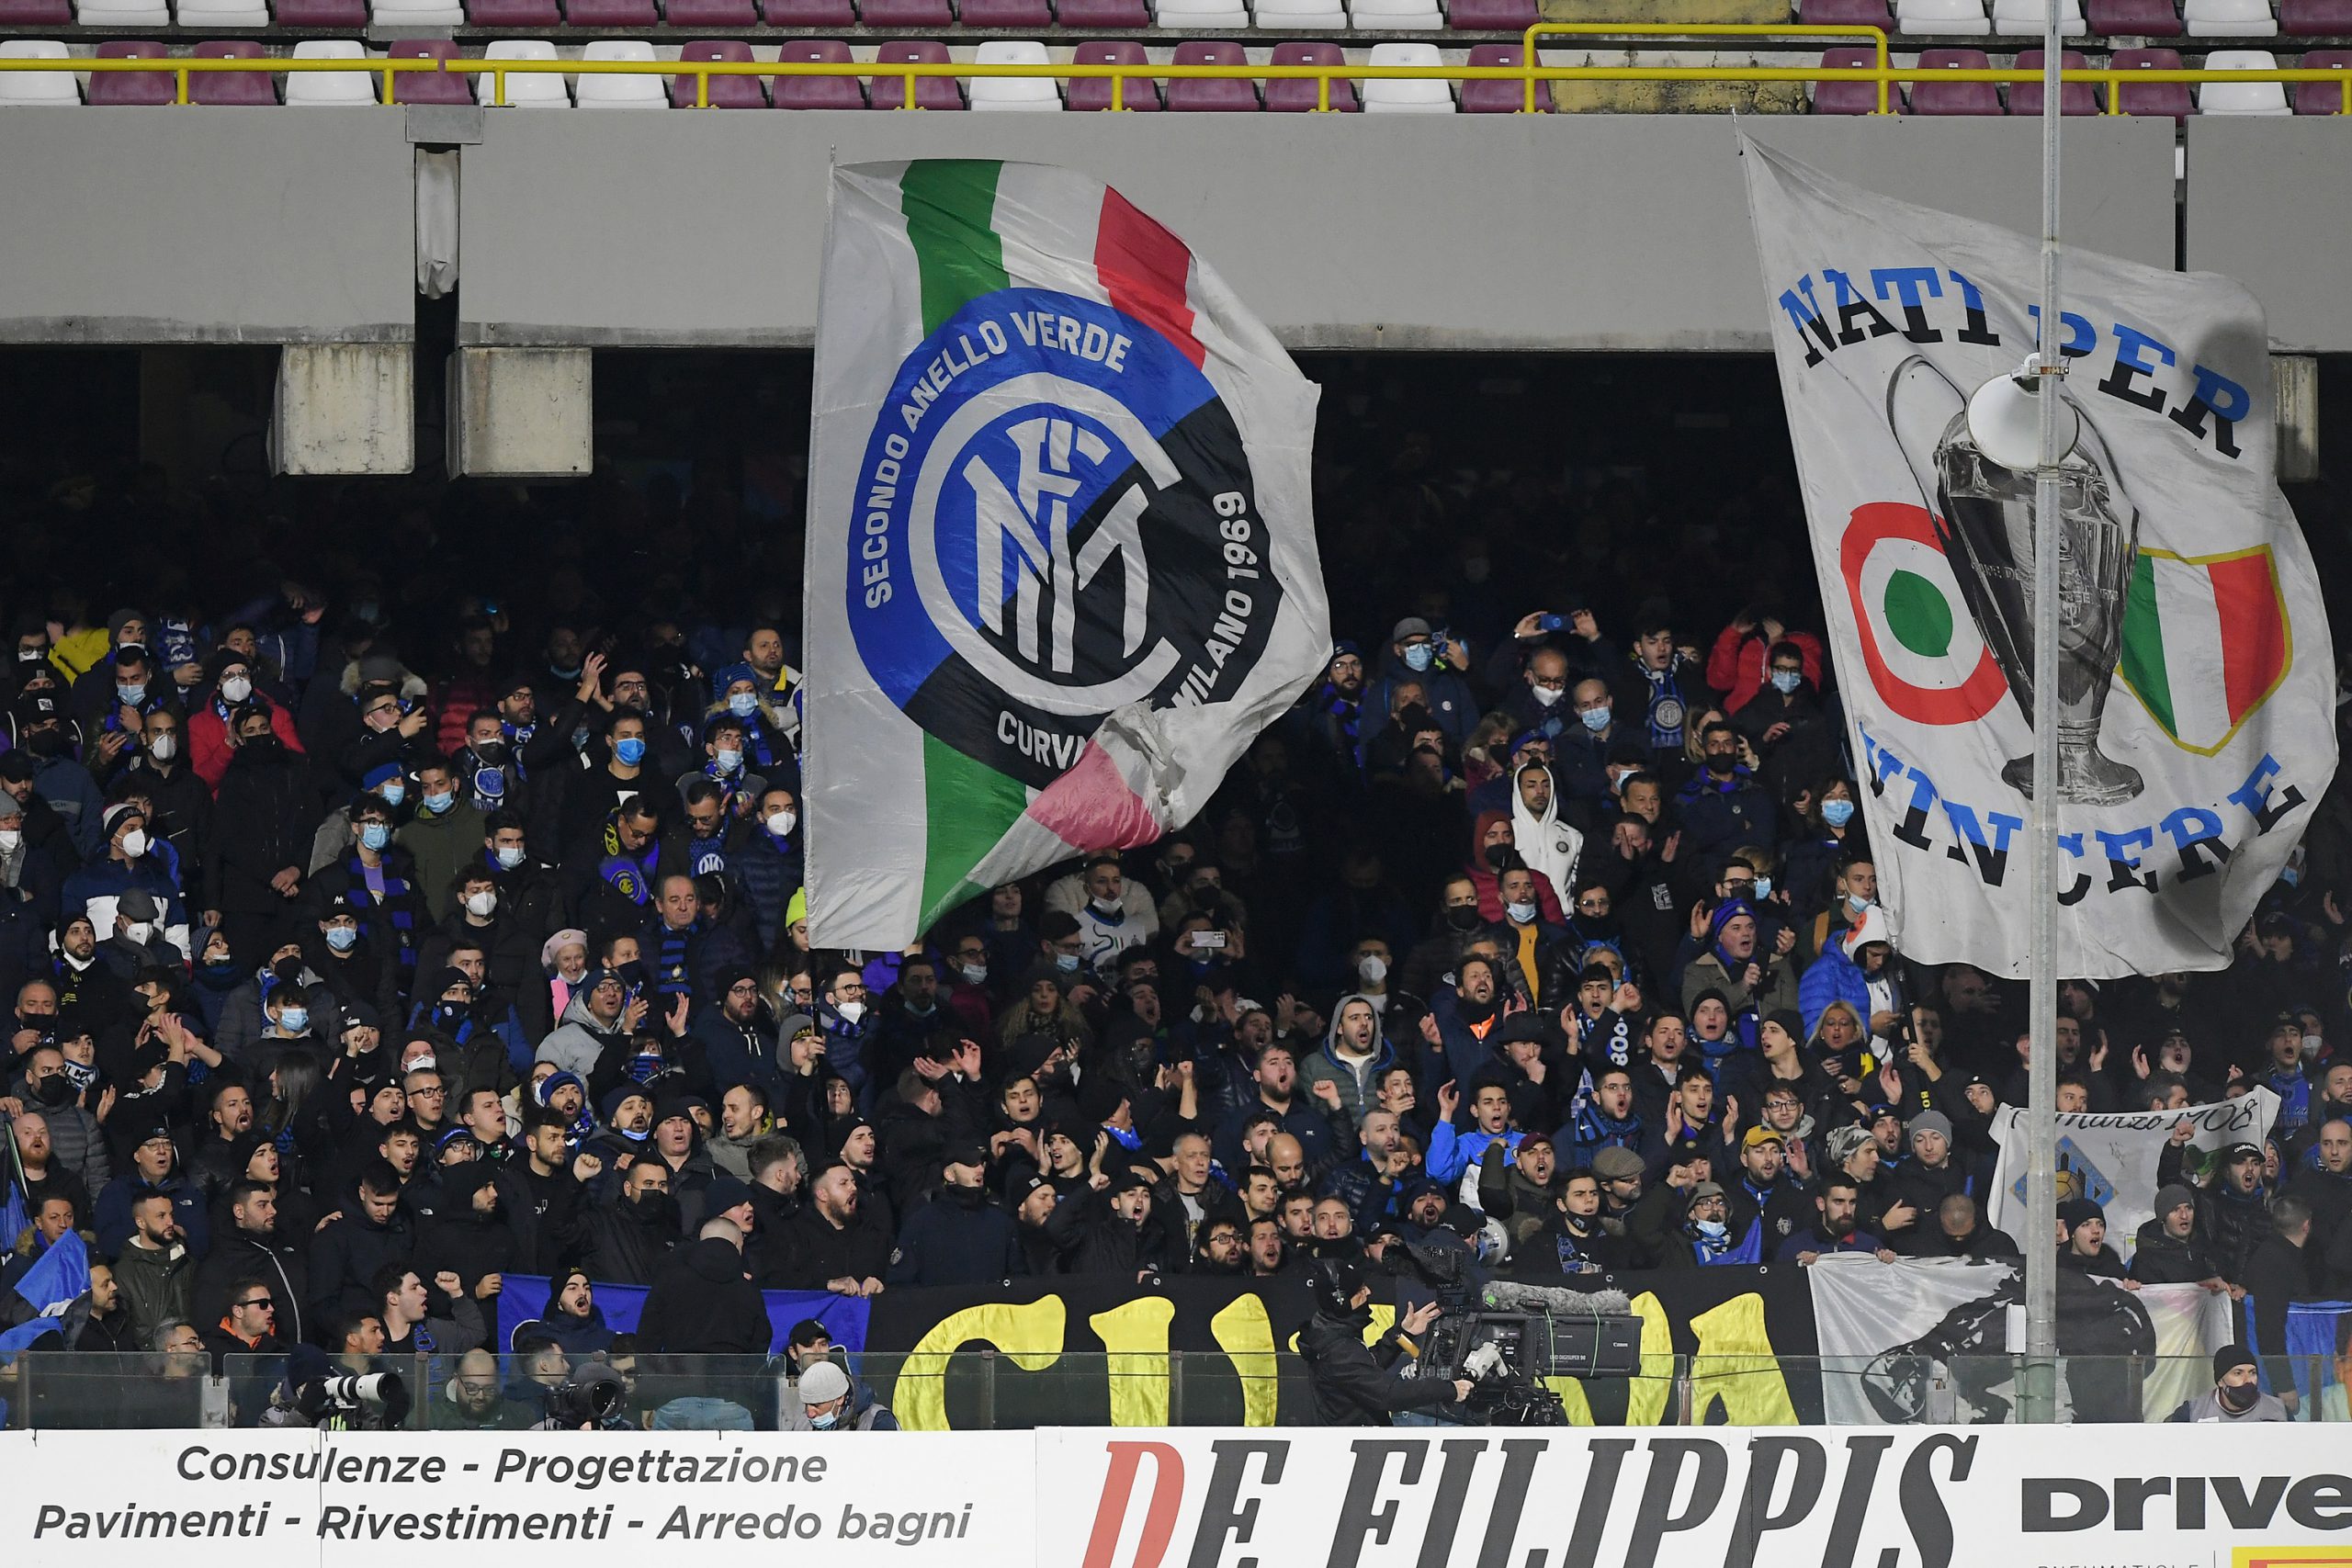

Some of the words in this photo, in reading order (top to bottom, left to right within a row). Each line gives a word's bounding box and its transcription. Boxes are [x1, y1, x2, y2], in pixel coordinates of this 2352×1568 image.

[1779, 266, 2001, 368] NATI
[2028, 304, 2250, 459] PER
[862, 433, 910, 609] SECONDO
[900, 320, 1008, 434] ANELLO
[1010, 310, 1133, 373] VERDE
[1170, 589, 1252, 706] MILANO
[1213, 491, 1260, 580] 1969
[34, 1501, 271, 1539] Pavimenti
[317, 1504, 614, 1540] Rivestimenti
[657, 1504, 820, 1540] Arredo
[837, 1503, 973, 1546] bagni
[177, 1445, 447, 1483] Consulenze
[494, 1448, 828, 1491] Progettazione
[1081, 1439, 1292, 1568] DE
[1327, 1433, 1980, 1568] FILIPPIS
